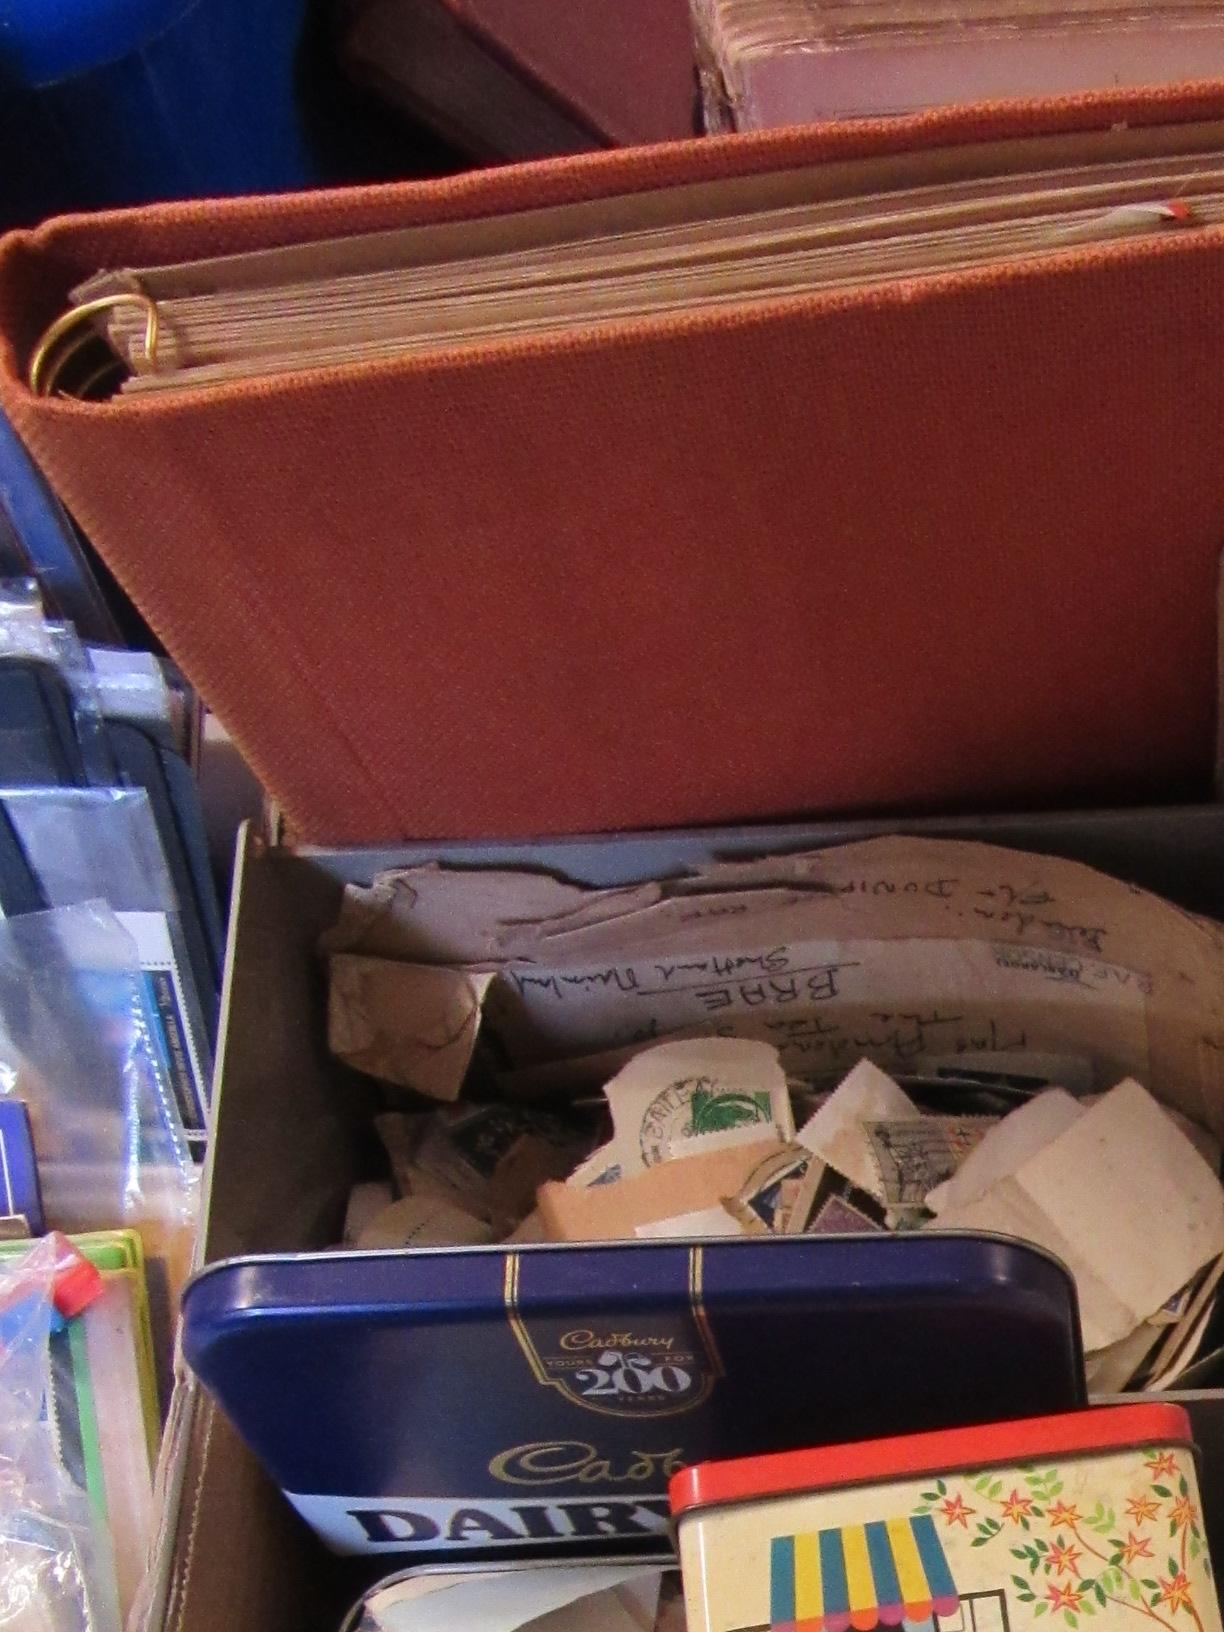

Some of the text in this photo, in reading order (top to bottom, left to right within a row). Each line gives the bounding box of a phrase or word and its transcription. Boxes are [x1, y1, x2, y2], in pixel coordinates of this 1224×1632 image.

[696, 968, 840, 1012] BRAE
[559, 1328, 674, 1351] Cadbury
[575, 1364, 692, 1396] 200
